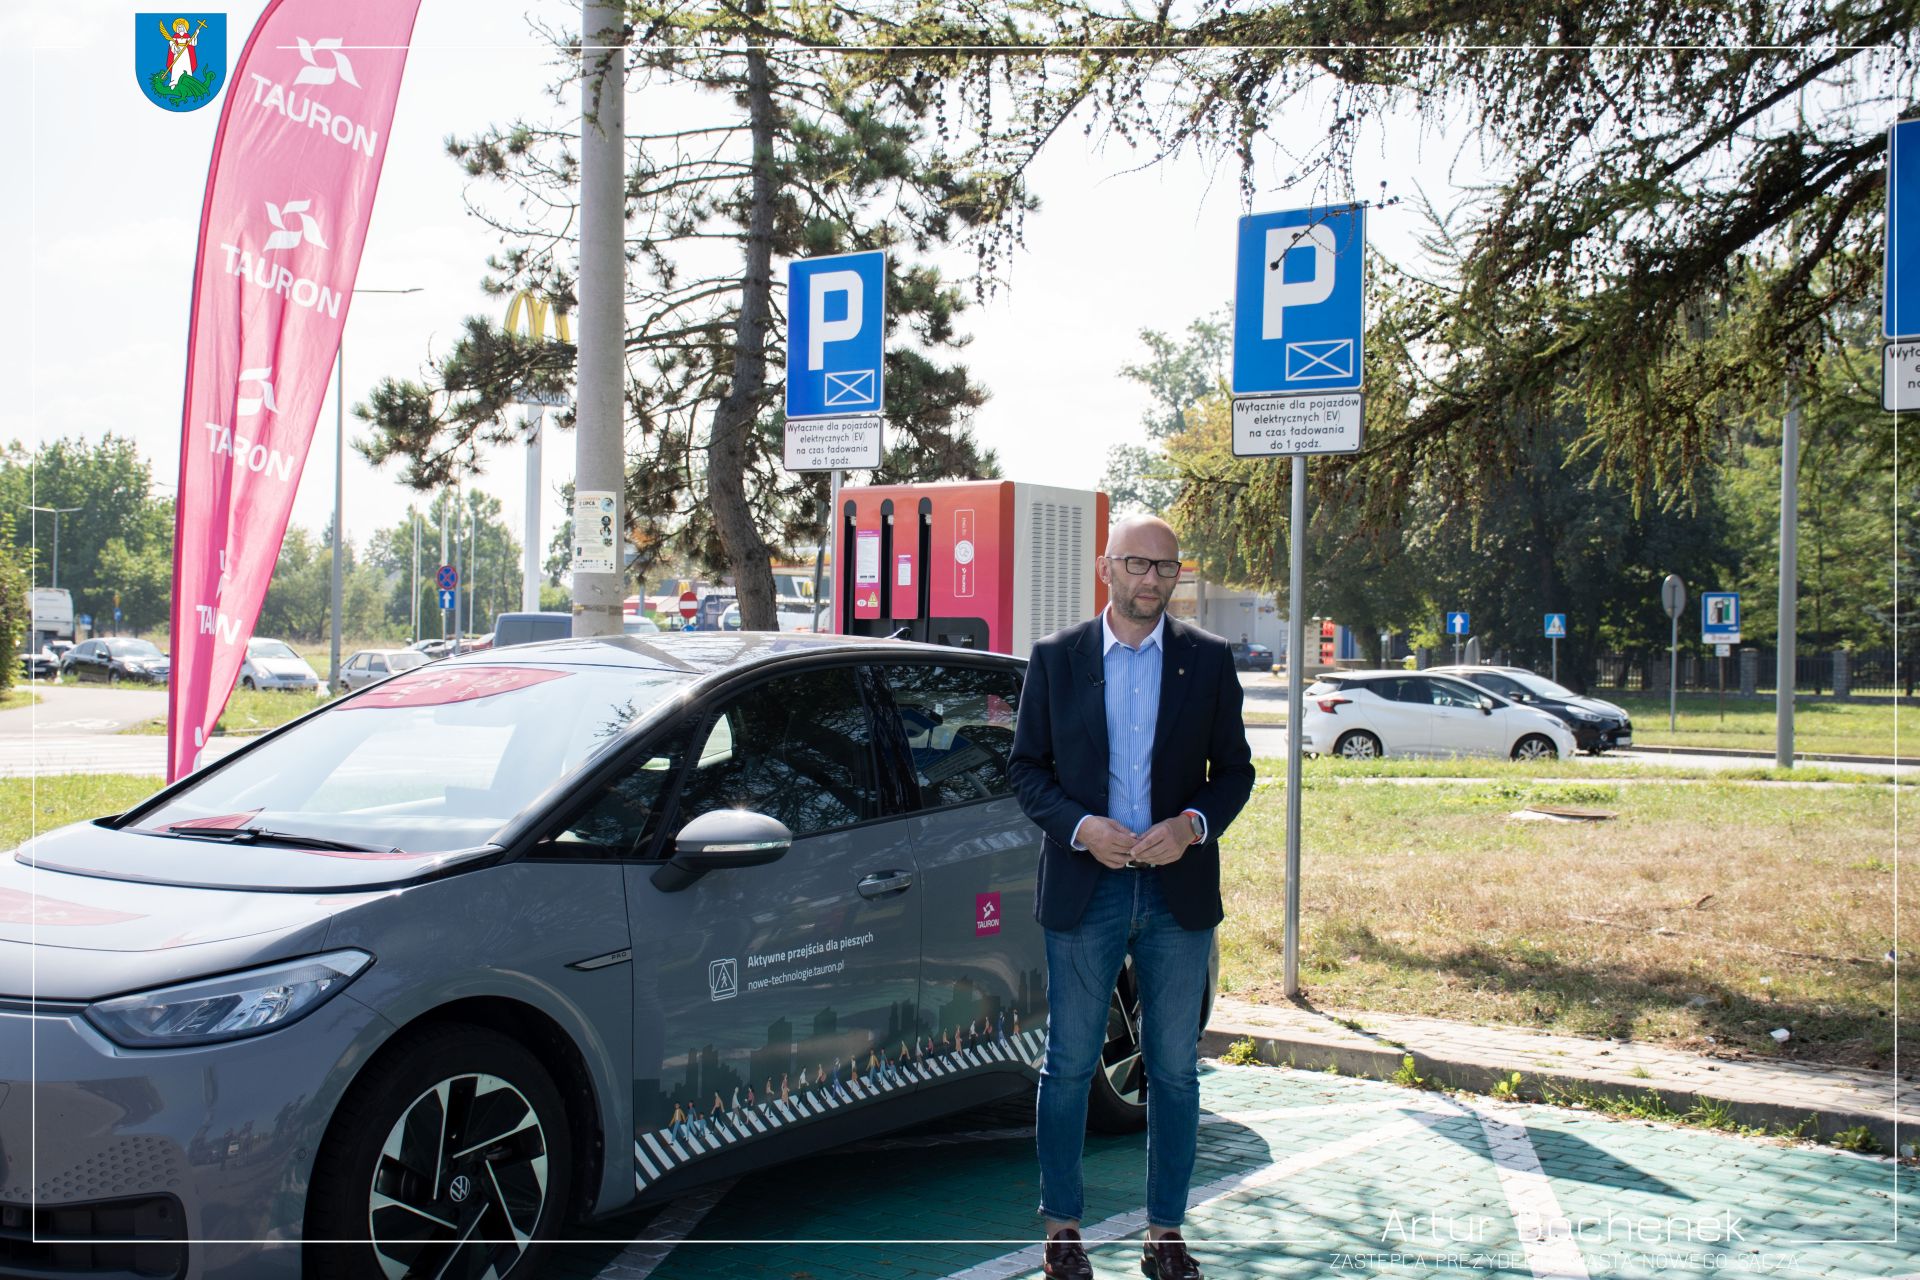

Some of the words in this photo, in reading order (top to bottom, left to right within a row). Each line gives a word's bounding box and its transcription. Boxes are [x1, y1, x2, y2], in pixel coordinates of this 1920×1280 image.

[251, 72, 378, 158] TAURON
[220, 242, 342, 319] TAURON
[1262, 223, 1336, 340] P
[808, 270, 863, 371] P
[1289, 399, 1306, 410] dla
[1254, 413, 1319, 425] elektrycznych
[1323, 411, 1341, 424] (EV)
[826, 421, 839, 431] dla
[1249, 430, 1261, 438] na
[1265, 427, 1287, 437] czas
[1290, 425, 1345, 436] ładowania
[800, 433, 849, 444] elektrycznych
[1270, 440, 1283, 450] do
[1286, 440, 1291, 449] 1
[1294, 438, 1322, 452] godz.
[204, 421, 294, 482] TARON
[796, 447, 806, 455] na
[808, 445, 825, 454] czas
[828, 444, 868, 454] ładowania
[811, 456, 822, 466] do
[824, 456, 828, 465] 1
[976, 918, 1000, 929] TAURON
[611, 951, 627, 960] PRO
[748, 953, 786, 968] Aktywne
[788, 944, 824, 962] przejścia
[825, 939, 839, 952] dla
[840, 932, 874, 951] pieszych
[748, 960, 845, 991] nowe-technologie.tauron.pl
